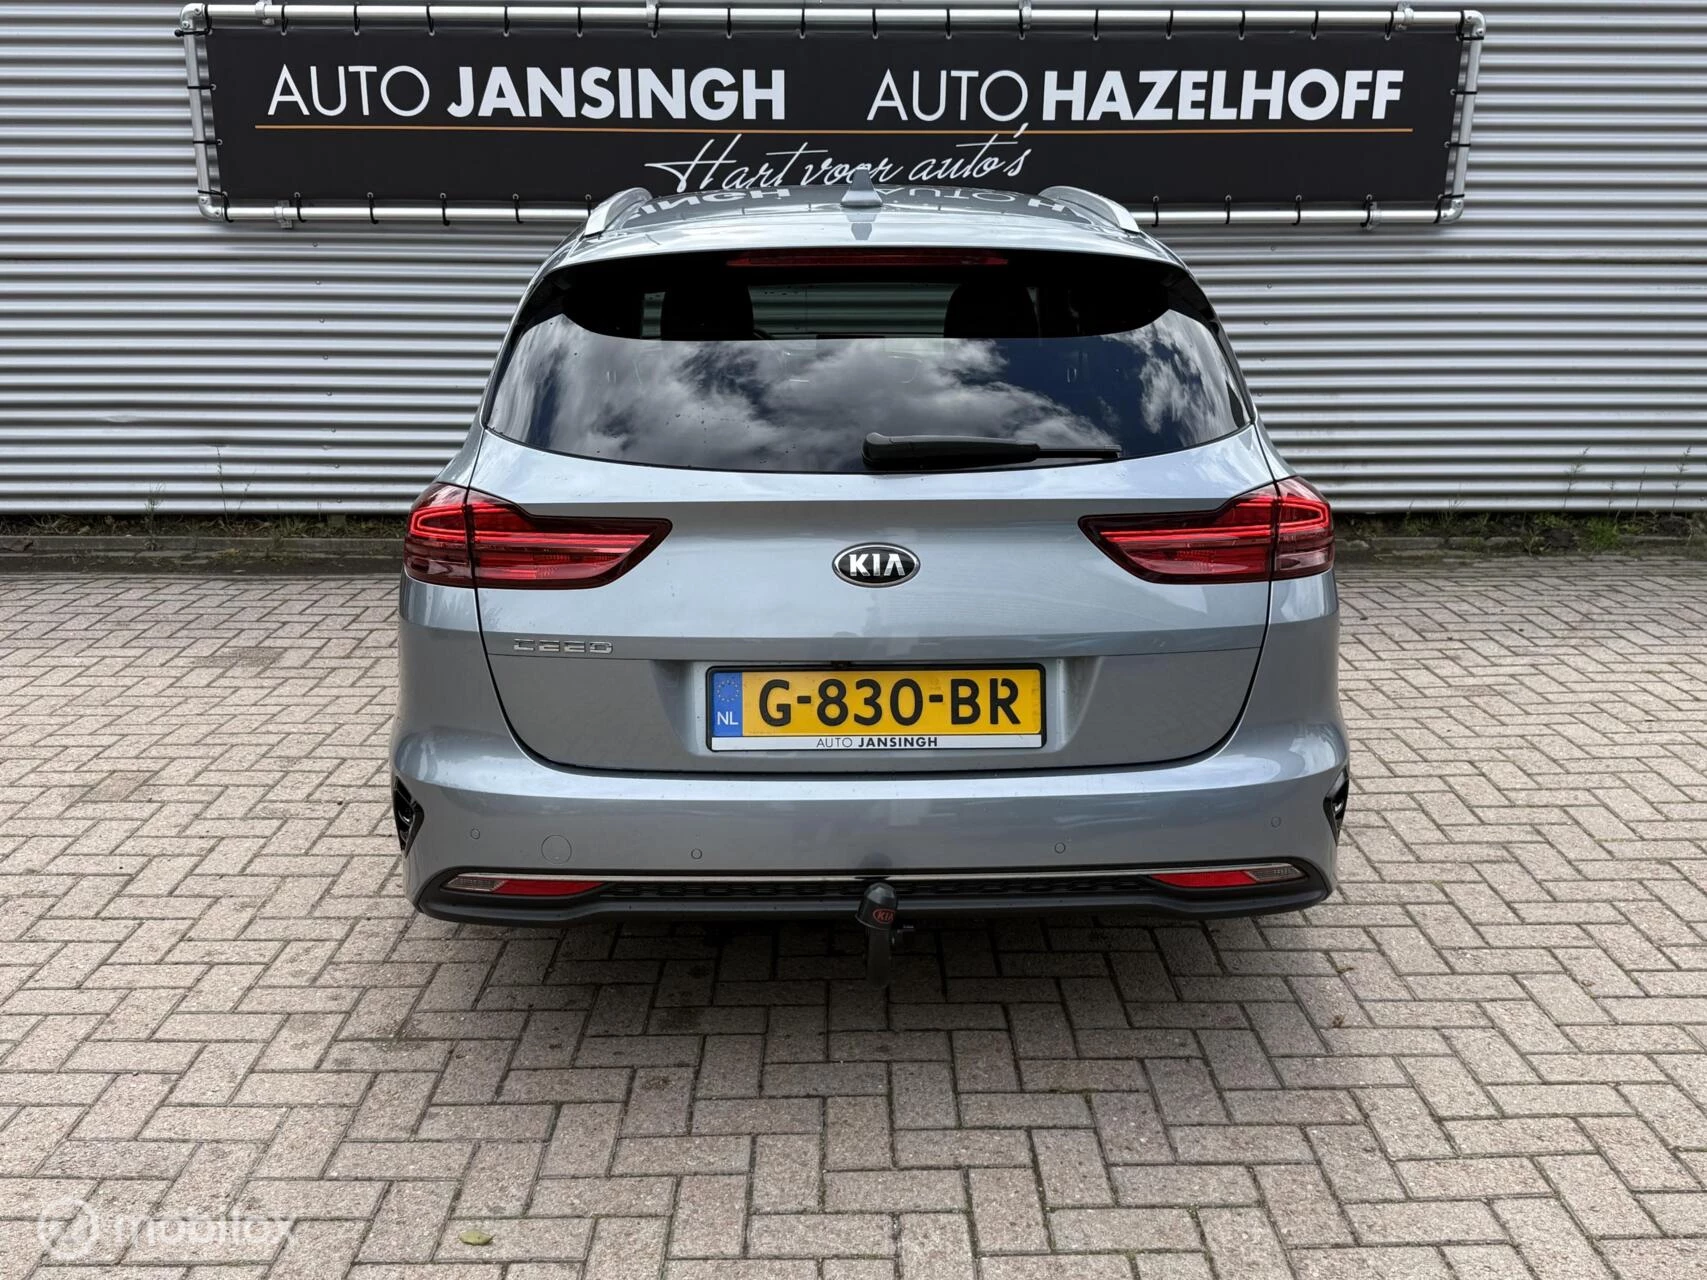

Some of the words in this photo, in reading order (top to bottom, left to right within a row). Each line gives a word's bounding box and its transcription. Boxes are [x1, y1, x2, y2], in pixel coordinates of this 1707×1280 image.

[267, 63, 431, 117] AUTO
[447, 66, 786, 121] JANSINGH
[867, 69, 1028, 122] AUTO
[1042, 68, 1404, 121] HAZELHOFF
[645, 133, 828, 193] Hart
[908, 122, 1032, 181] auto's
[849, 553, 906, 577] KIA
[716, 711, 739, 726] NL
[759, 678, 1021, 726] G-830-BR
[816, 738, 853, 748] AUTO
[858, 736, 938, 748] JANSINGH
